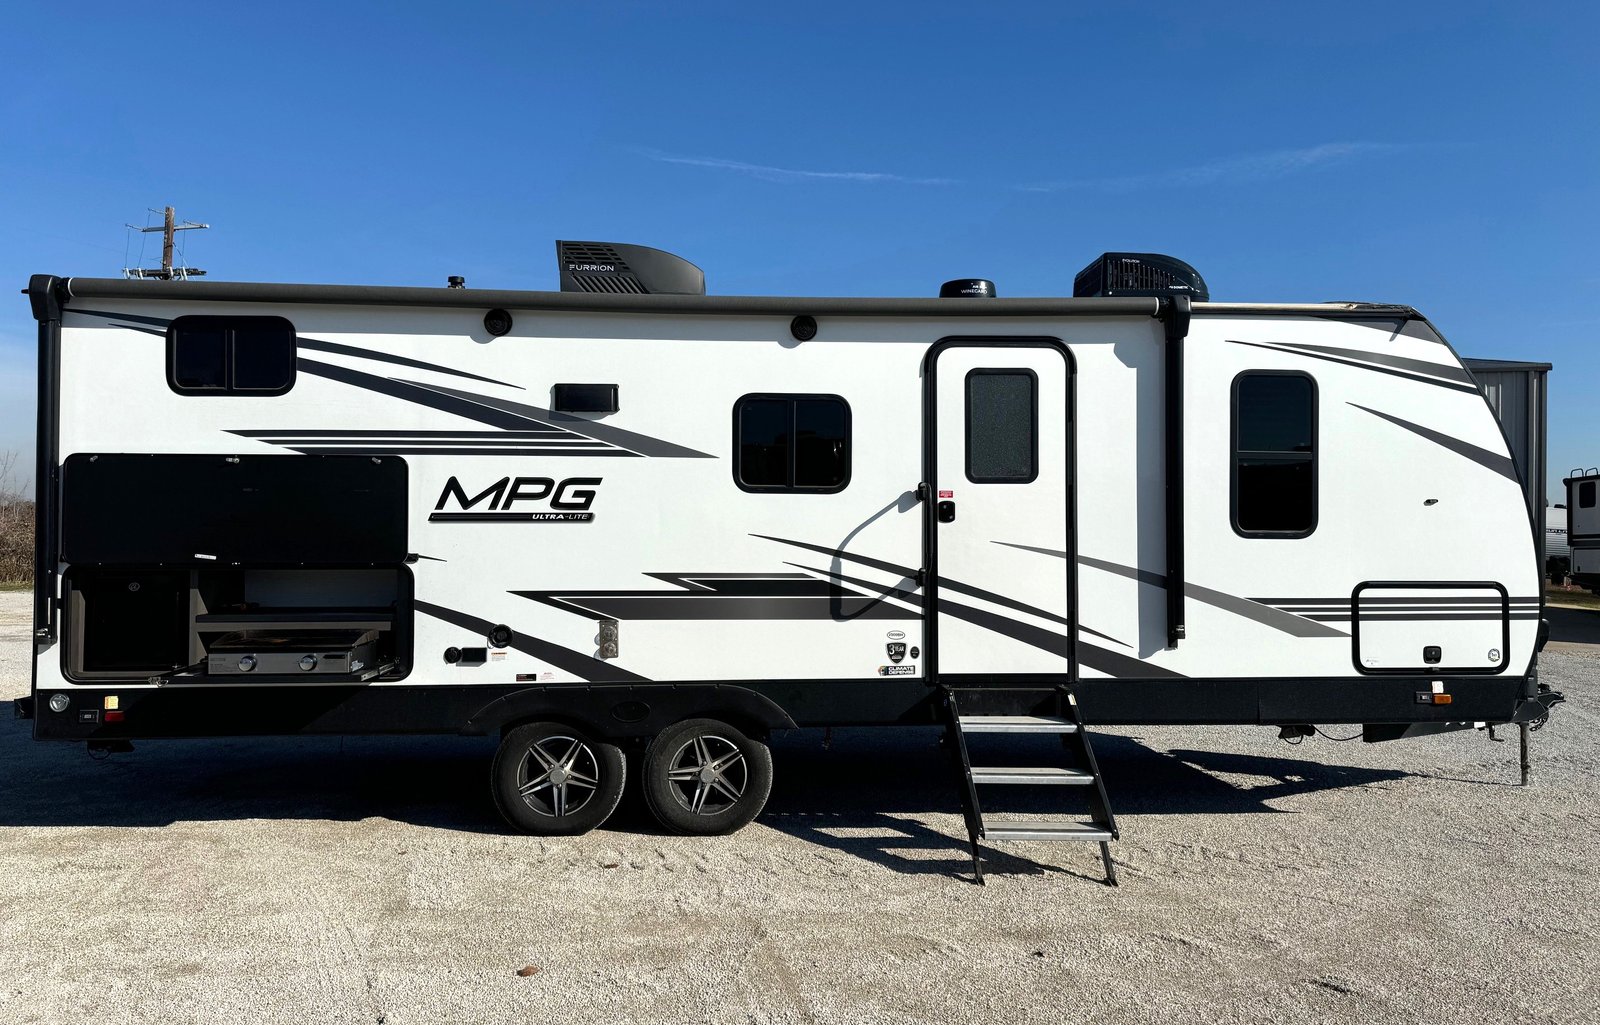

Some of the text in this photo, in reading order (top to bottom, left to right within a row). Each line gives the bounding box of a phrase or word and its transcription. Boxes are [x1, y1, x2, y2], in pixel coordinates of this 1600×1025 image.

[568, 264, 615, 272] FURRION
[434, 475, 604, 511] MPG
[888, 644, 895, 655] 3
